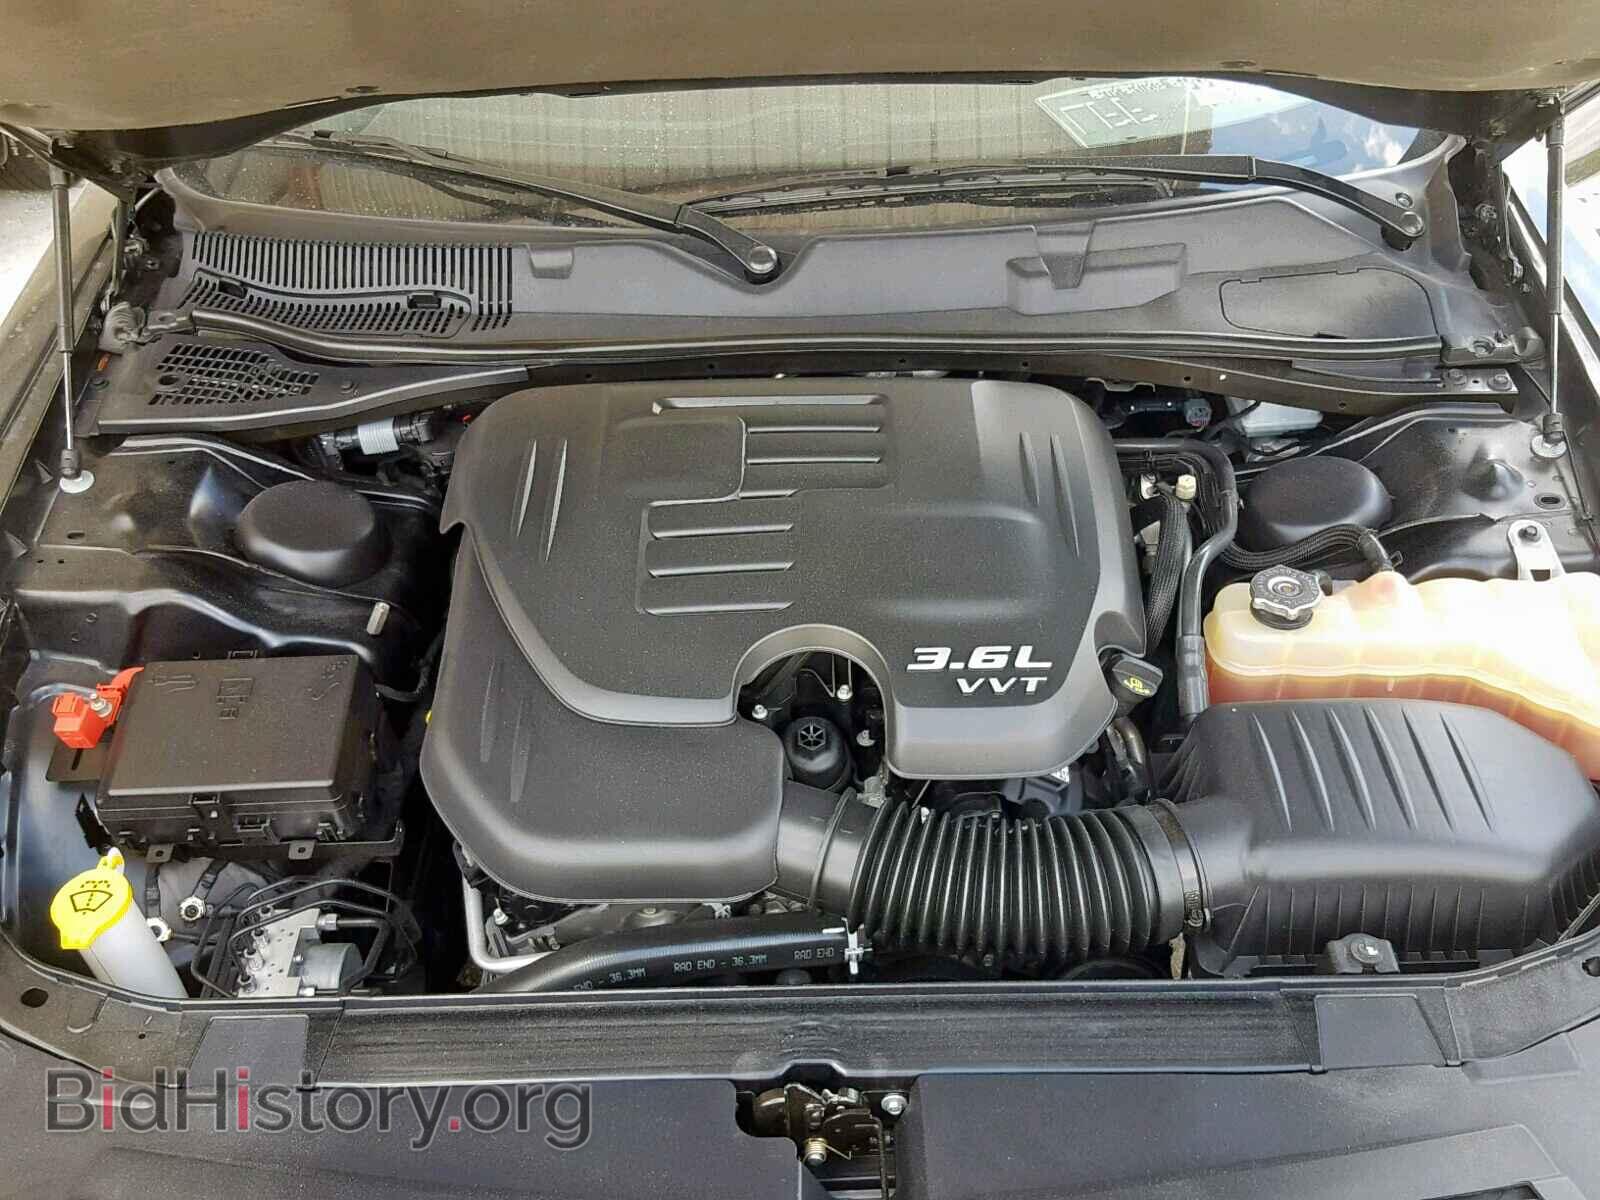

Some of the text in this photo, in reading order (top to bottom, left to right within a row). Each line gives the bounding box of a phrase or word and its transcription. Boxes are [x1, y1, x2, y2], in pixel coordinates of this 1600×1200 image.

[906, 646, 1052, 670] 3.6L
[957, 677, 1047, 693] VVT
[674, 961, 692, 973] RAD
[697, 959, 715, 970] END
[794, 949, 812, 960] RAD
[816, 947, 834, 958] END
